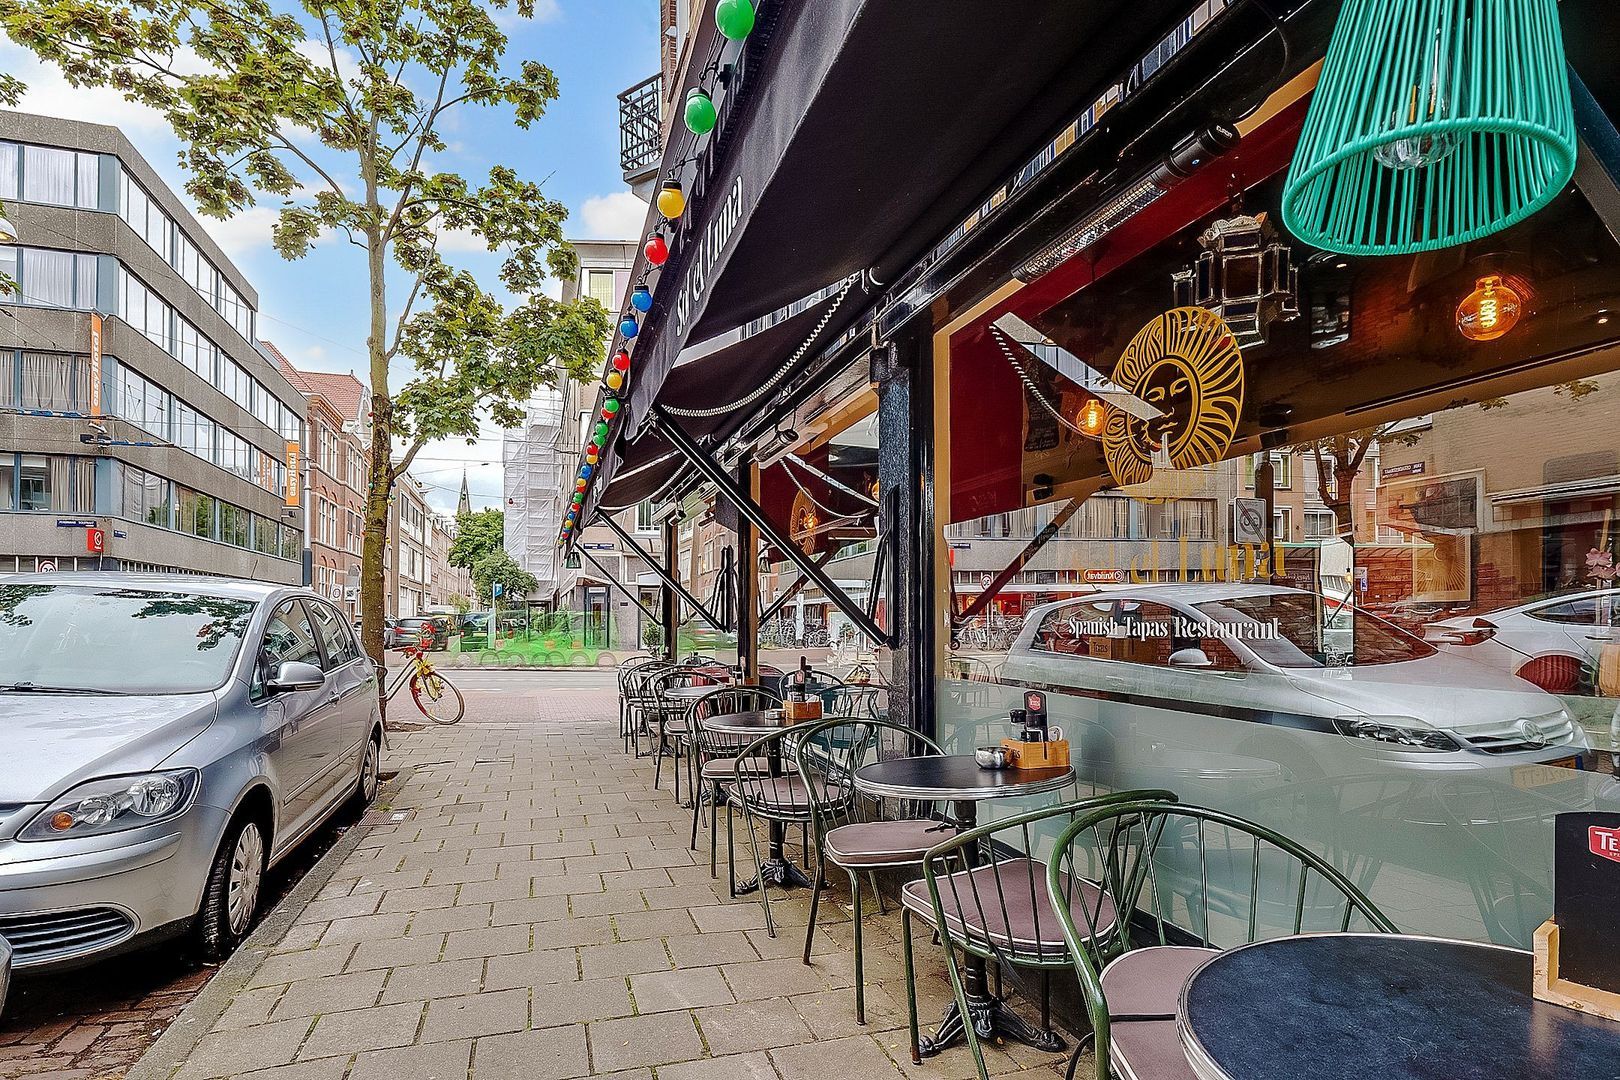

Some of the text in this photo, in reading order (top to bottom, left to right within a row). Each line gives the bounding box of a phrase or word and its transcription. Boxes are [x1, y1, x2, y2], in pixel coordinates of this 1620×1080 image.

[706, 175, 743, 278] Luna
[288, 452, 297, 497] easyHotel
[1069, 616, 1283, 642] Spanish Tapas Restaurant
